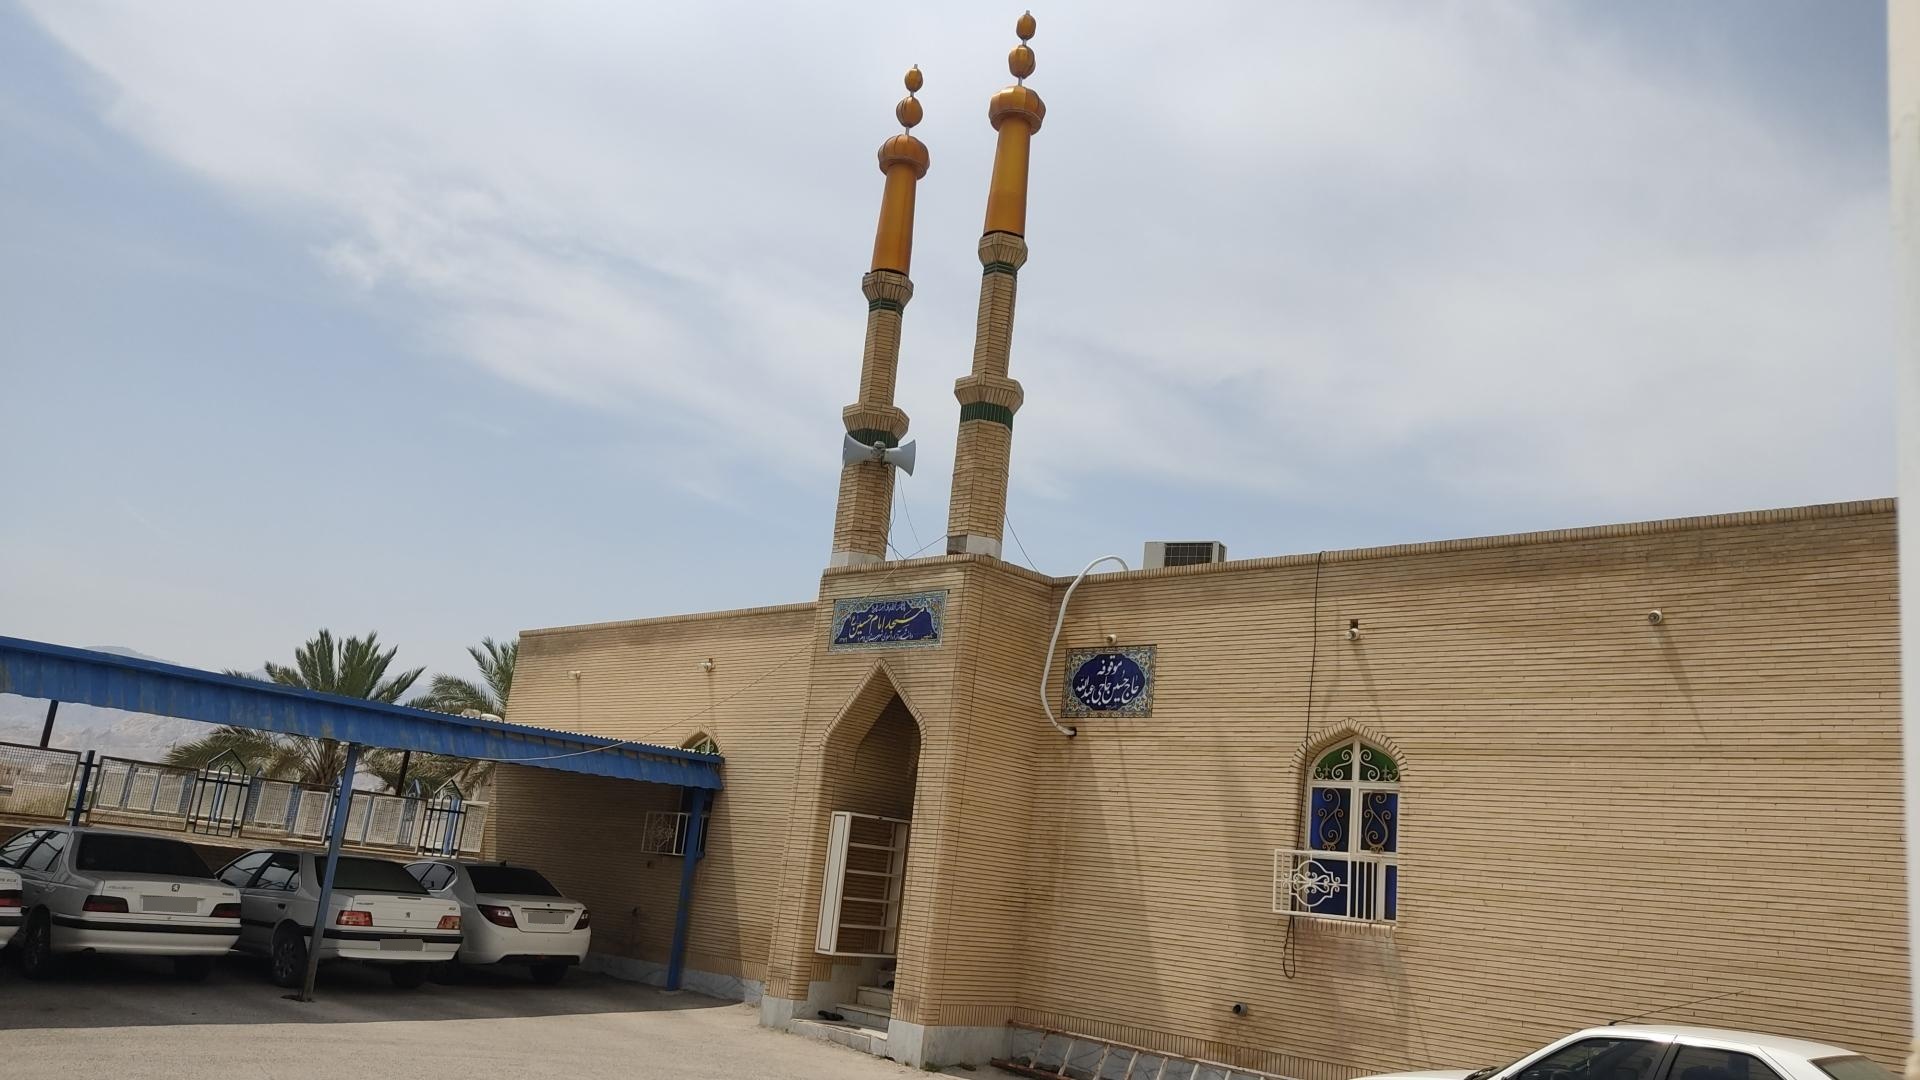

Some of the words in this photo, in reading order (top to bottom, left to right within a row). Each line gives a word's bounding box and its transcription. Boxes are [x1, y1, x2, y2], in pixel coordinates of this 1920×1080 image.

[849, 614, 874, 638] حسین
[869, 614, 886, 633] امام
[885, 607, 925, 632] مسجد
[1097, 655, 1122, 675] موقوفه
[1121, 675, 1139, 703] حاج
